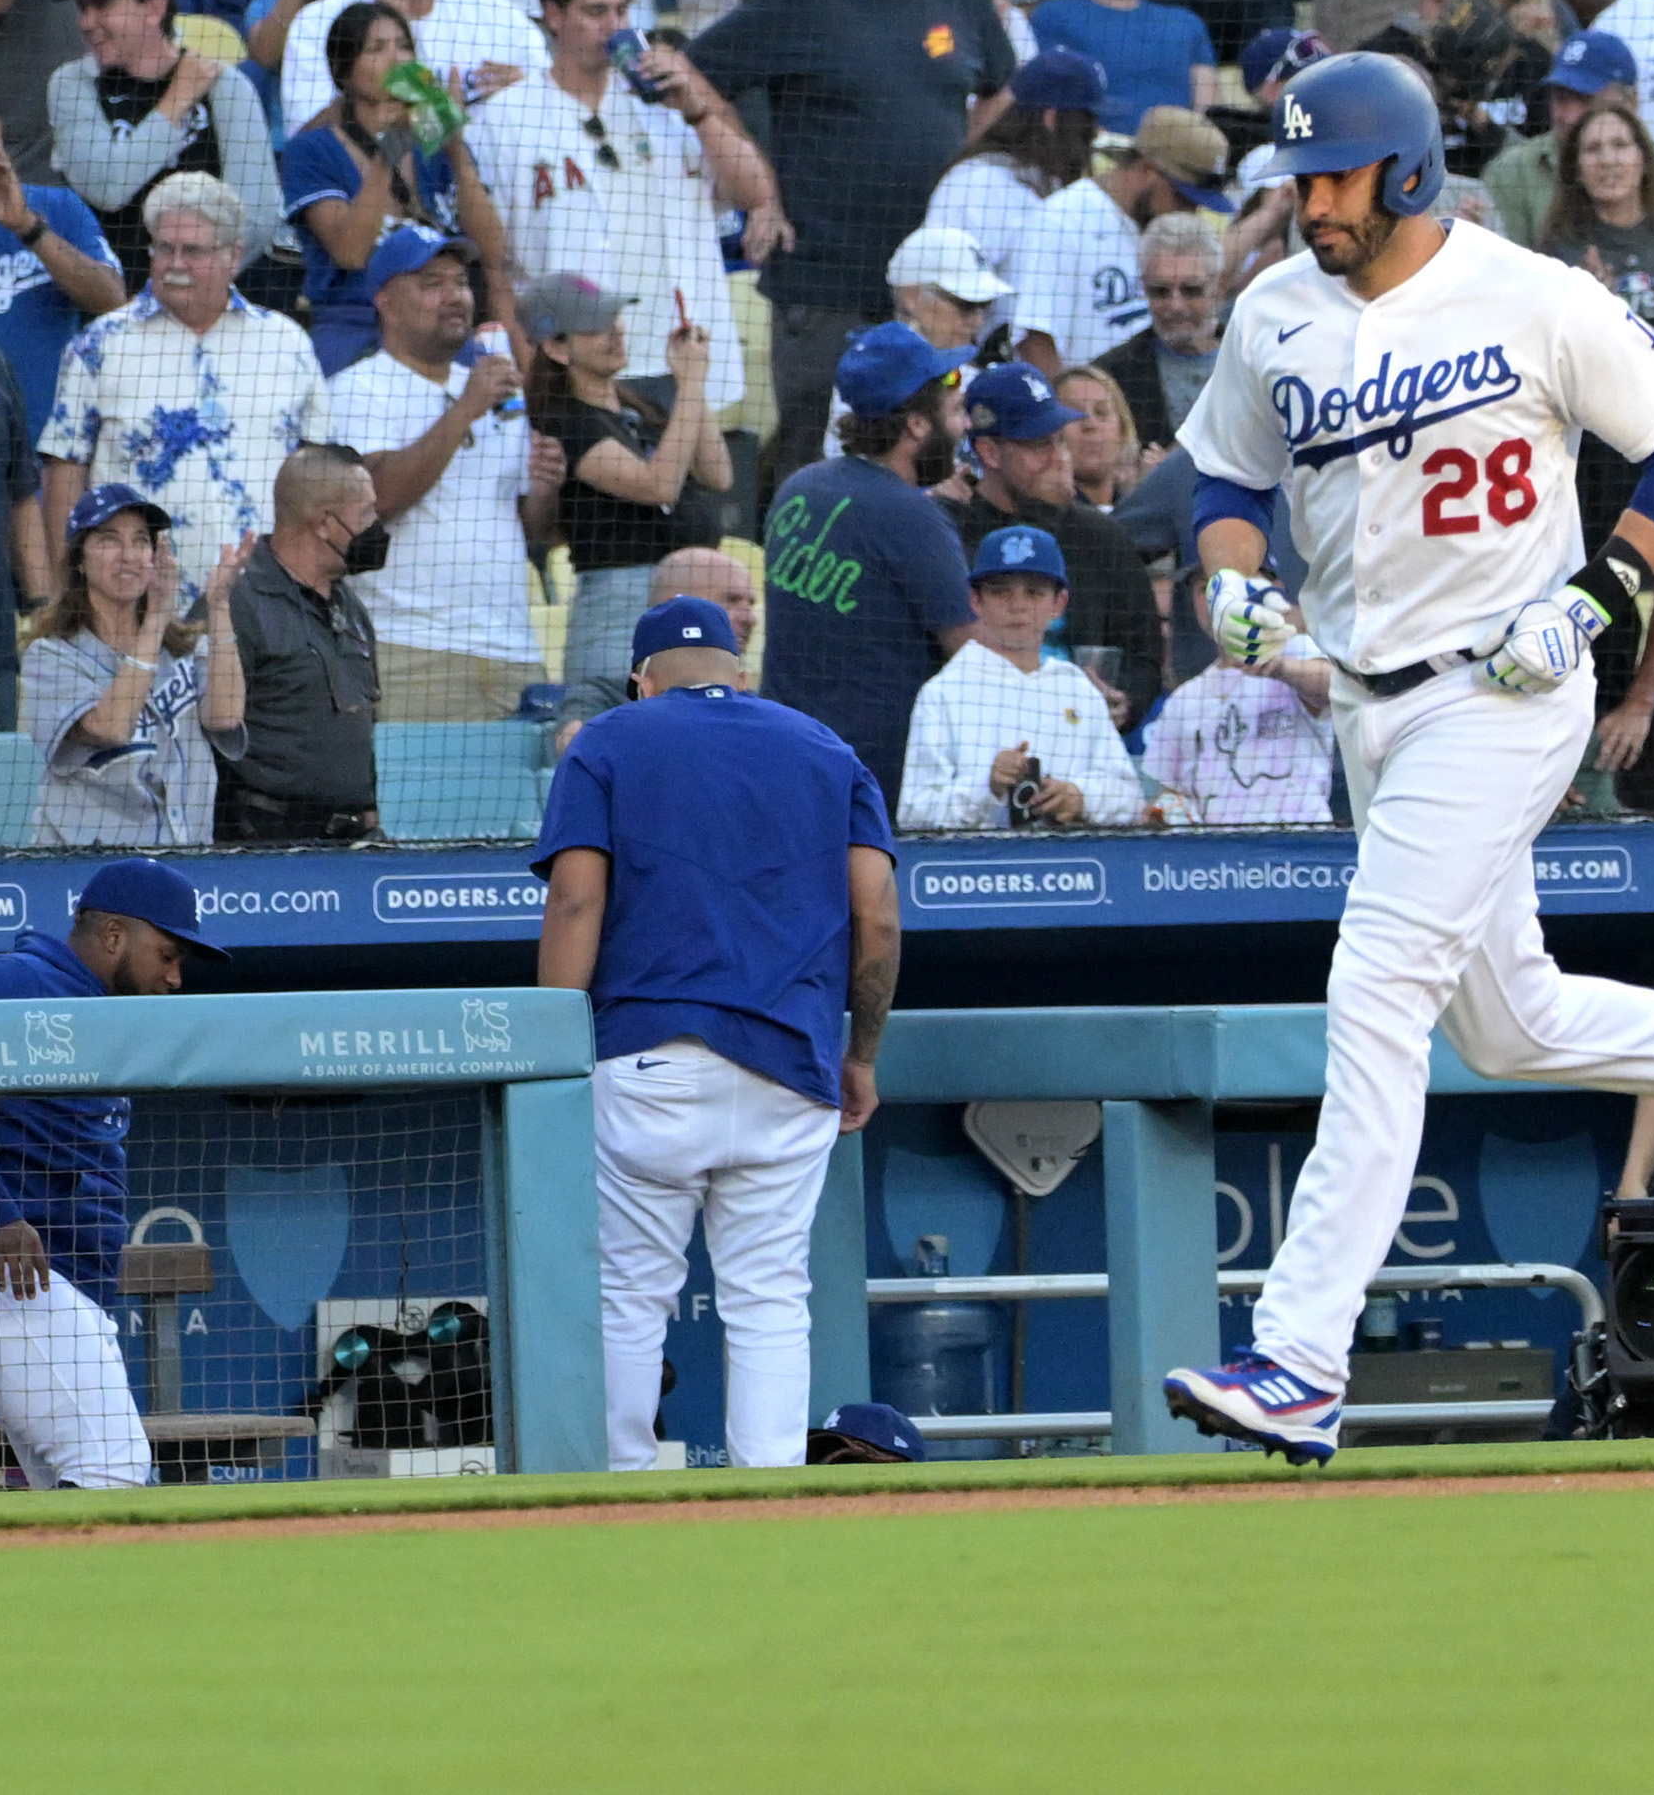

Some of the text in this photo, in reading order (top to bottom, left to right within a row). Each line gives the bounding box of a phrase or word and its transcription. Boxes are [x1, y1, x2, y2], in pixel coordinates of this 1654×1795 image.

[1283, 93, 1313, 139] LA
[1272, 344, 1521, 461] Dodgers
[1422, 438, 1538, 537] 28
[924, 873, 1095, 895] DODGERS.COM
[300, 1029, 455, 1056] MERRILL
[22, 1072, 101, 1086] COMPANY
[301, 1060, 535, 1077] A BANK OF AMERICA COMPANY
